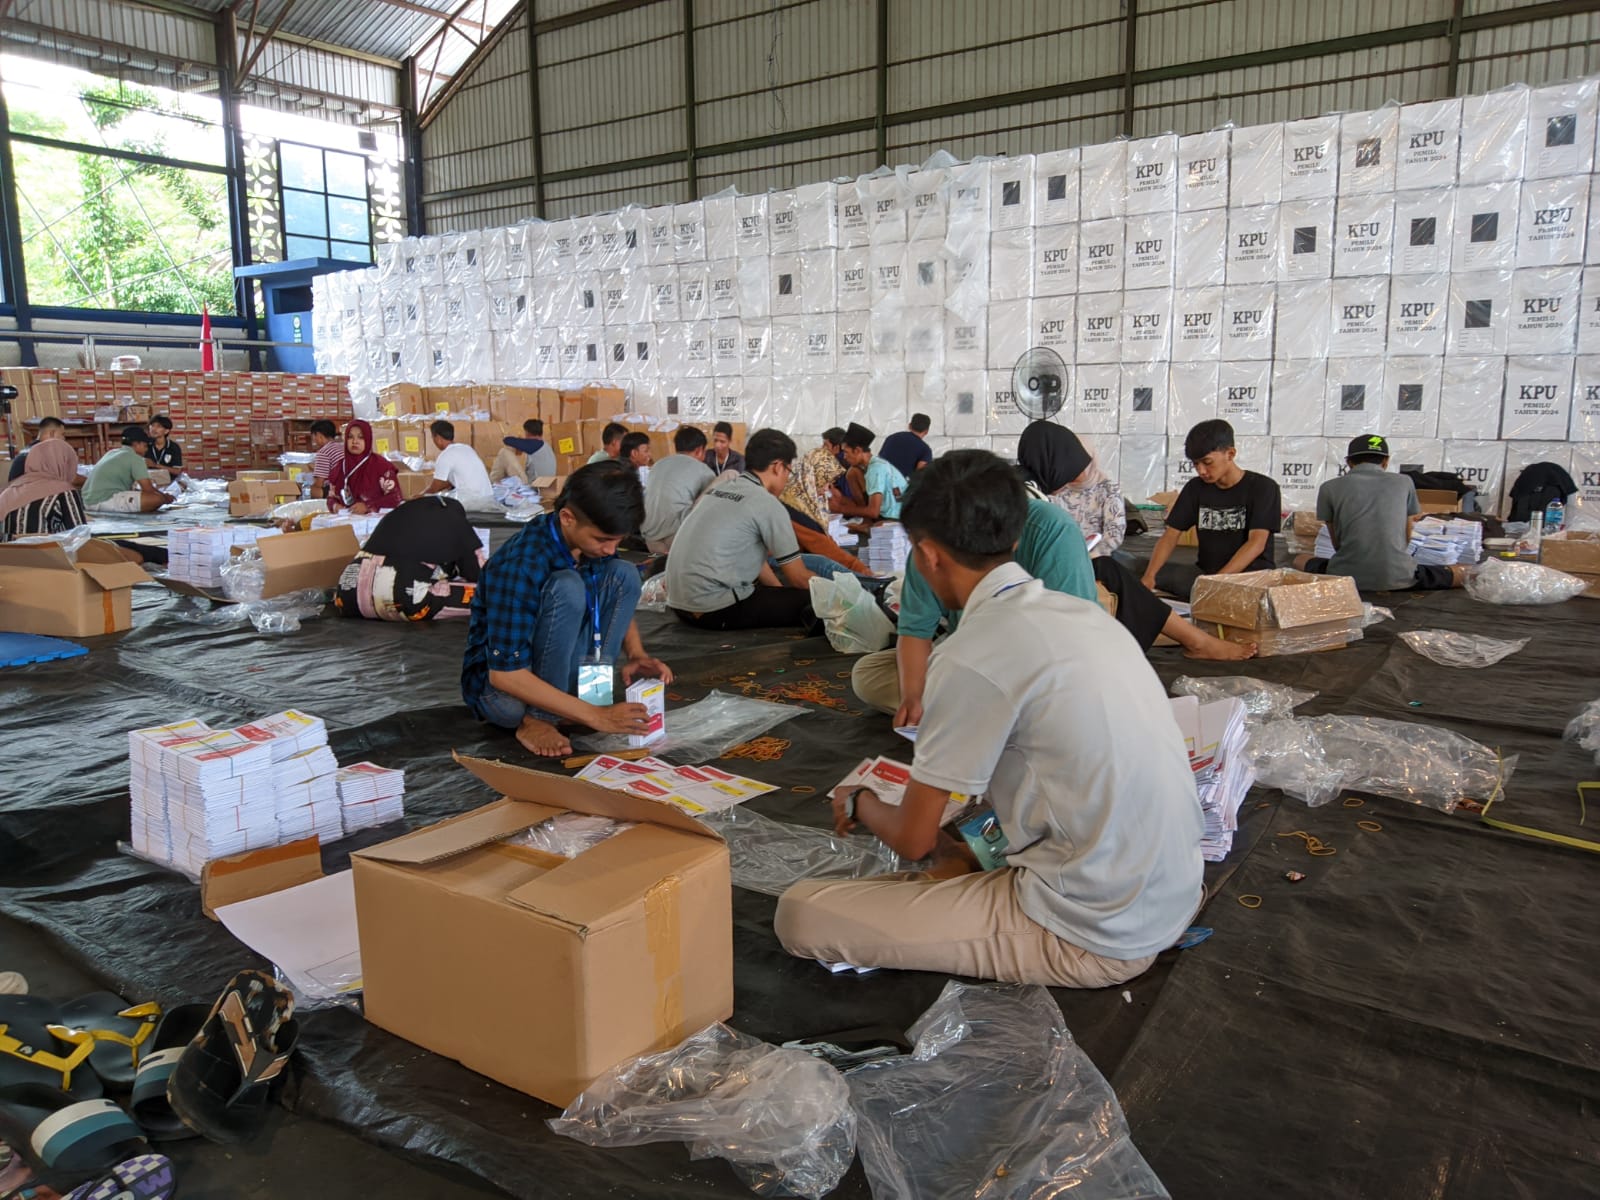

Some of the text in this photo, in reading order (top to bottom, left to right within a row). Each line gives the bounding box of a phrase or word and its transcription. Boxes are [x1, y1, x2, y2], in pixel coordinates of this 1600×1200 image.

[1409, 130, 1445, 149] KPU
[1293, 145, 1325, 162] KPU
[1136, 163, 1163, 179] KPU
[1188, 158, 1216, 175] KPU
[742, 215, 759, 228] KPU
[775, 211, 793, 225] KPU
[1534, 207, 1574, 225] KPU
[1348, 222, 1381, 238] KPU
[1135, 239, 1163, 254] KPU
[1238, 232, 1268, 248] KPU
[1043, 248, 1068, 263] KPU
[1088, 243, 1114, 258] KPU
[844, 268, 864, 281] KPU
[1343, 304, 1376, 319] KPU
[1400, 302, 1435, 317] KPU
[1523, 297, 1562, 313] KPU
[1087, 316, 1113, 330] KPU
[1133, 314, 1160, 328] KPU
[1184, 312, 1212, 327] KPU
[1232, 310, 1262, 325] KPU
[954, 326, 977, 339] KPU
[1040, 319, 1064, 334] KPU
[748, 338, 762, 349] KP
[843, 333, 863, 345] KPU
[1084, 388, 1109, 400] KPU
[1228, 386, 1257, 400] KPU
[1519, 385, 1558, 400] KPU
[1178, 461, 1195, 473] KP
[1282, 463, 1313, 476] KPU
[1455, 466, 1489, 481] KPU
